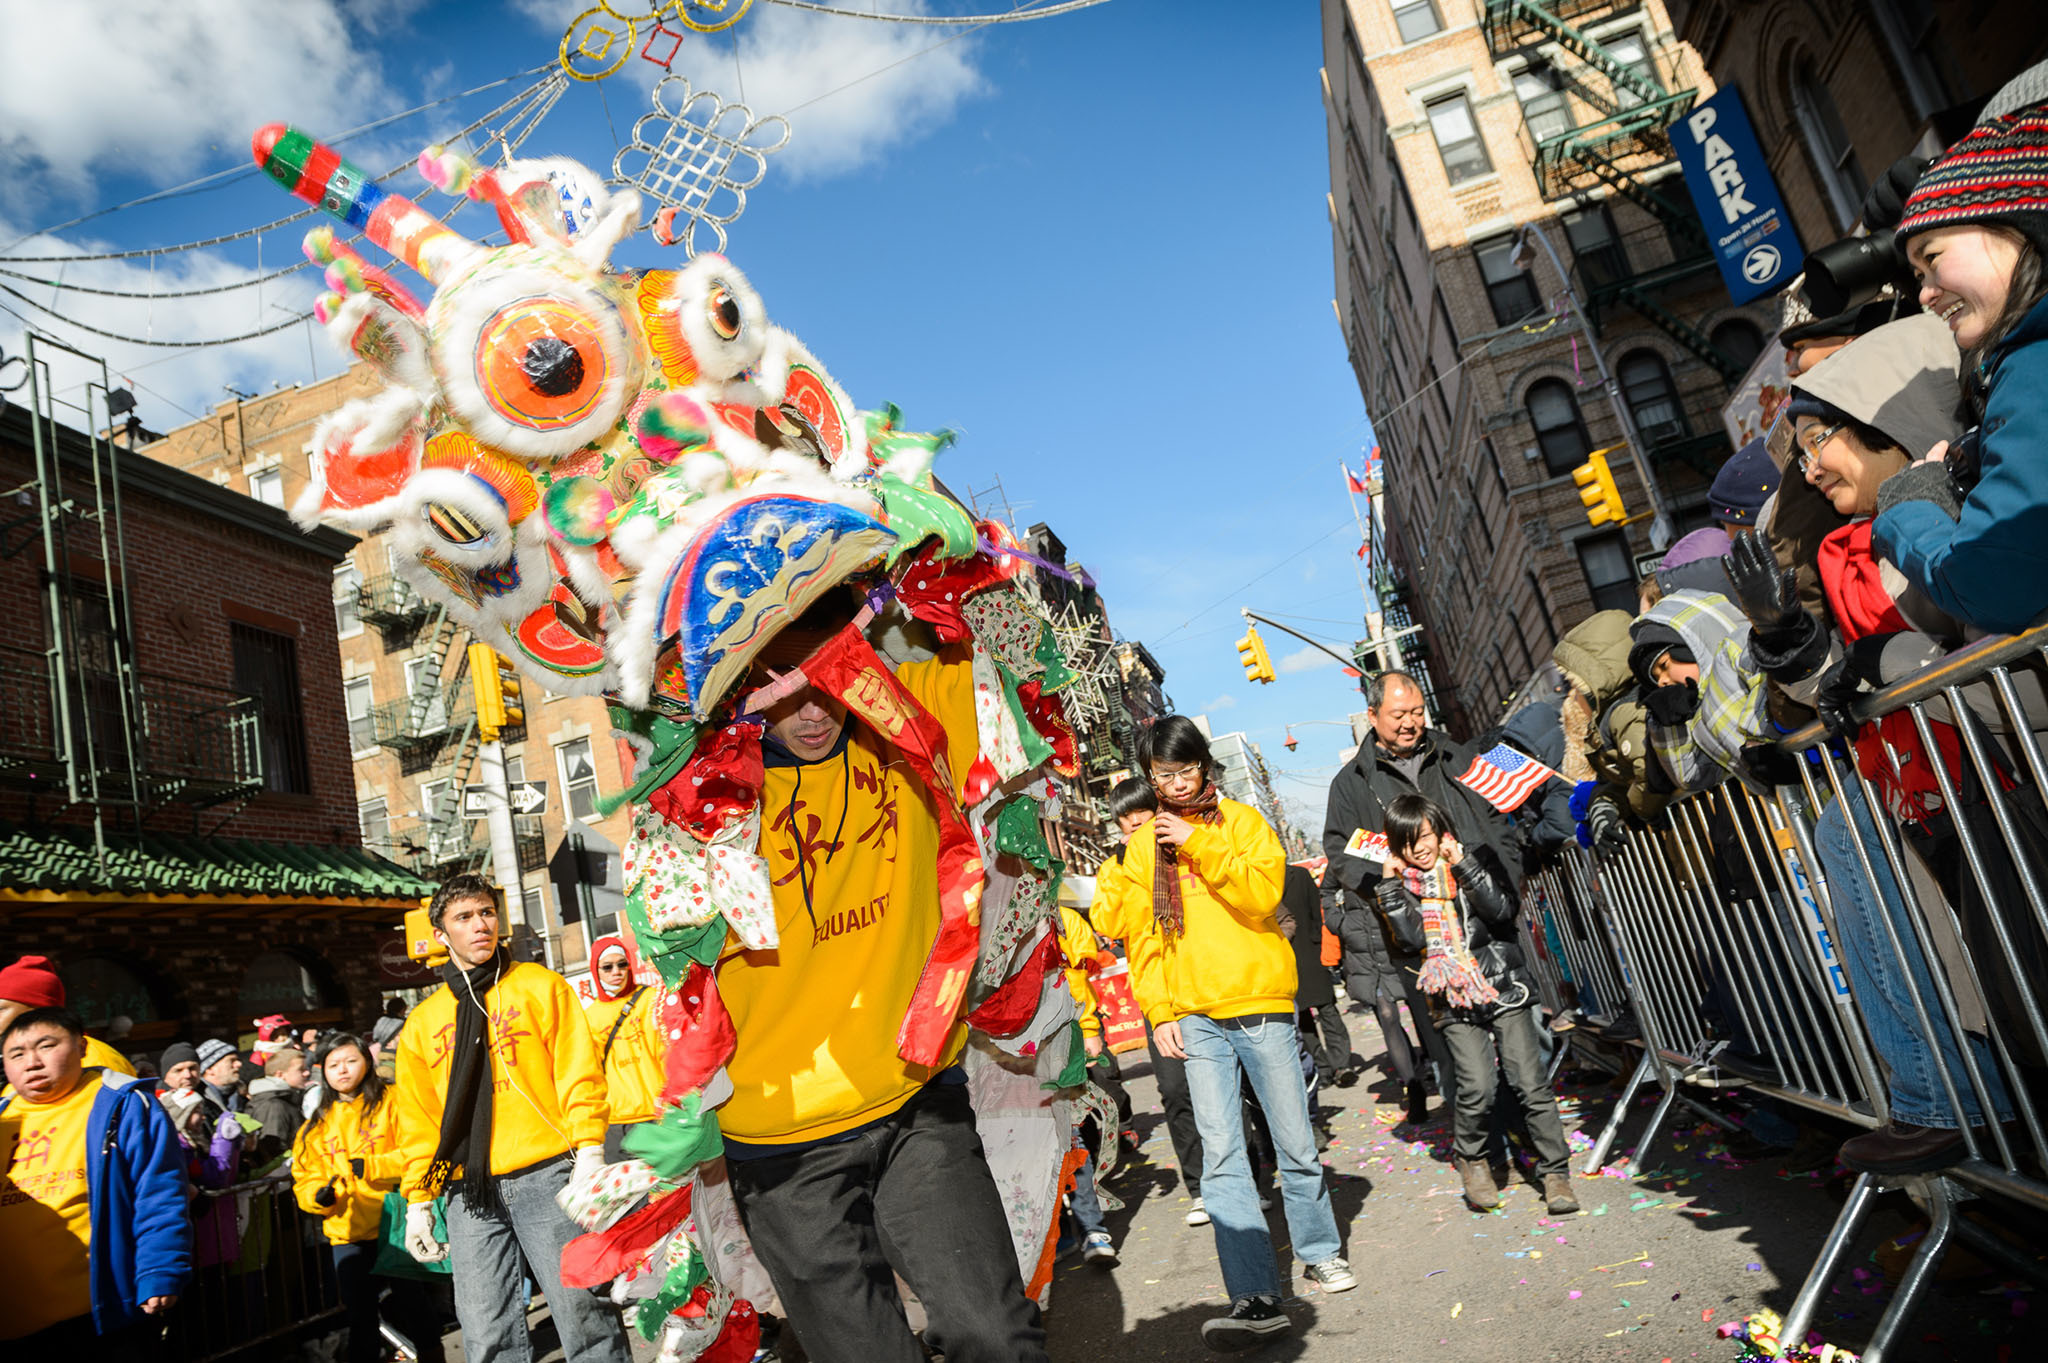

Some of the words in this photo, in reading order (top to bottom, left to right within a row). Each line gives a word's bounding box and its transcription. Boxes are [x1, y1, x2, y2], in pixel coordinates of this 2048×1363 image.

[1688, 107, 1756, 224] PARK
[1719, 229, 1741, 247] Open
[1645, 559, 1662, 571] ON
[512, 792, 536, 805] WAY
